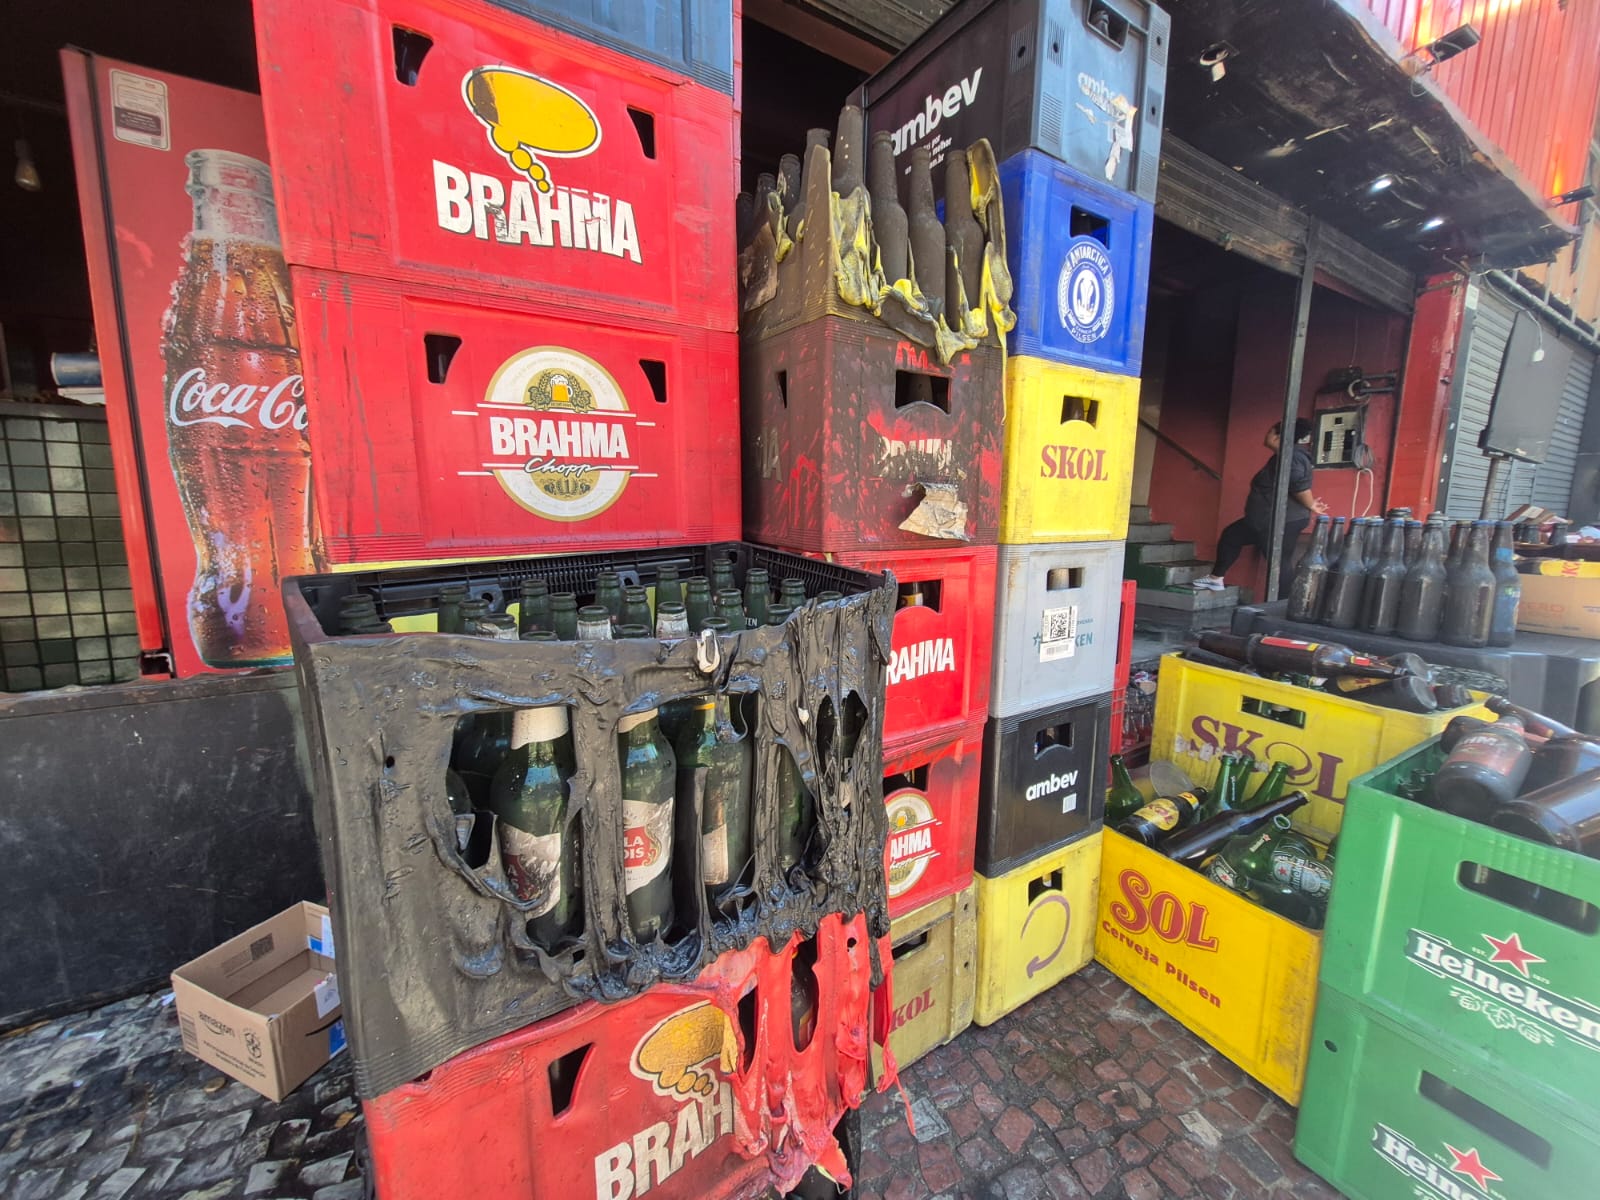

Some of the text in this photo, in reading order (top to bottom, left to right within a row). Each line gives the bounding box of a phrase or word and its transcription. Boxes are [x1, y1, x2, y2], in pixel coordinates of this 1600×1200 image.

[432, 159, 643, 265] BRAHMA
[1069, 245, 1110, 276] ANTARCTICA
[170, 367, 309, 431] Coca-Co
[489, 416, 630, 459] BRAHMA
[524, 457, 613, 478] Chopp
[1040, 444, 1108, 481] SKOL
[886, 637, 956, 687] RAHMA
[1025, 769, 1078, 801] ambev
[626, 835, 645, 849] LA
[890, 827, 932, 862] AHMA
[1110, 868, 1220, 953] SOL
[1102, 920, 1222, 1009] Cerveja Pilsen
[889, 987, 936, 1035] KOL
[1414, 936, 1600, 1044] Heineken
[594, 1080, 735, 1200] BRAH
